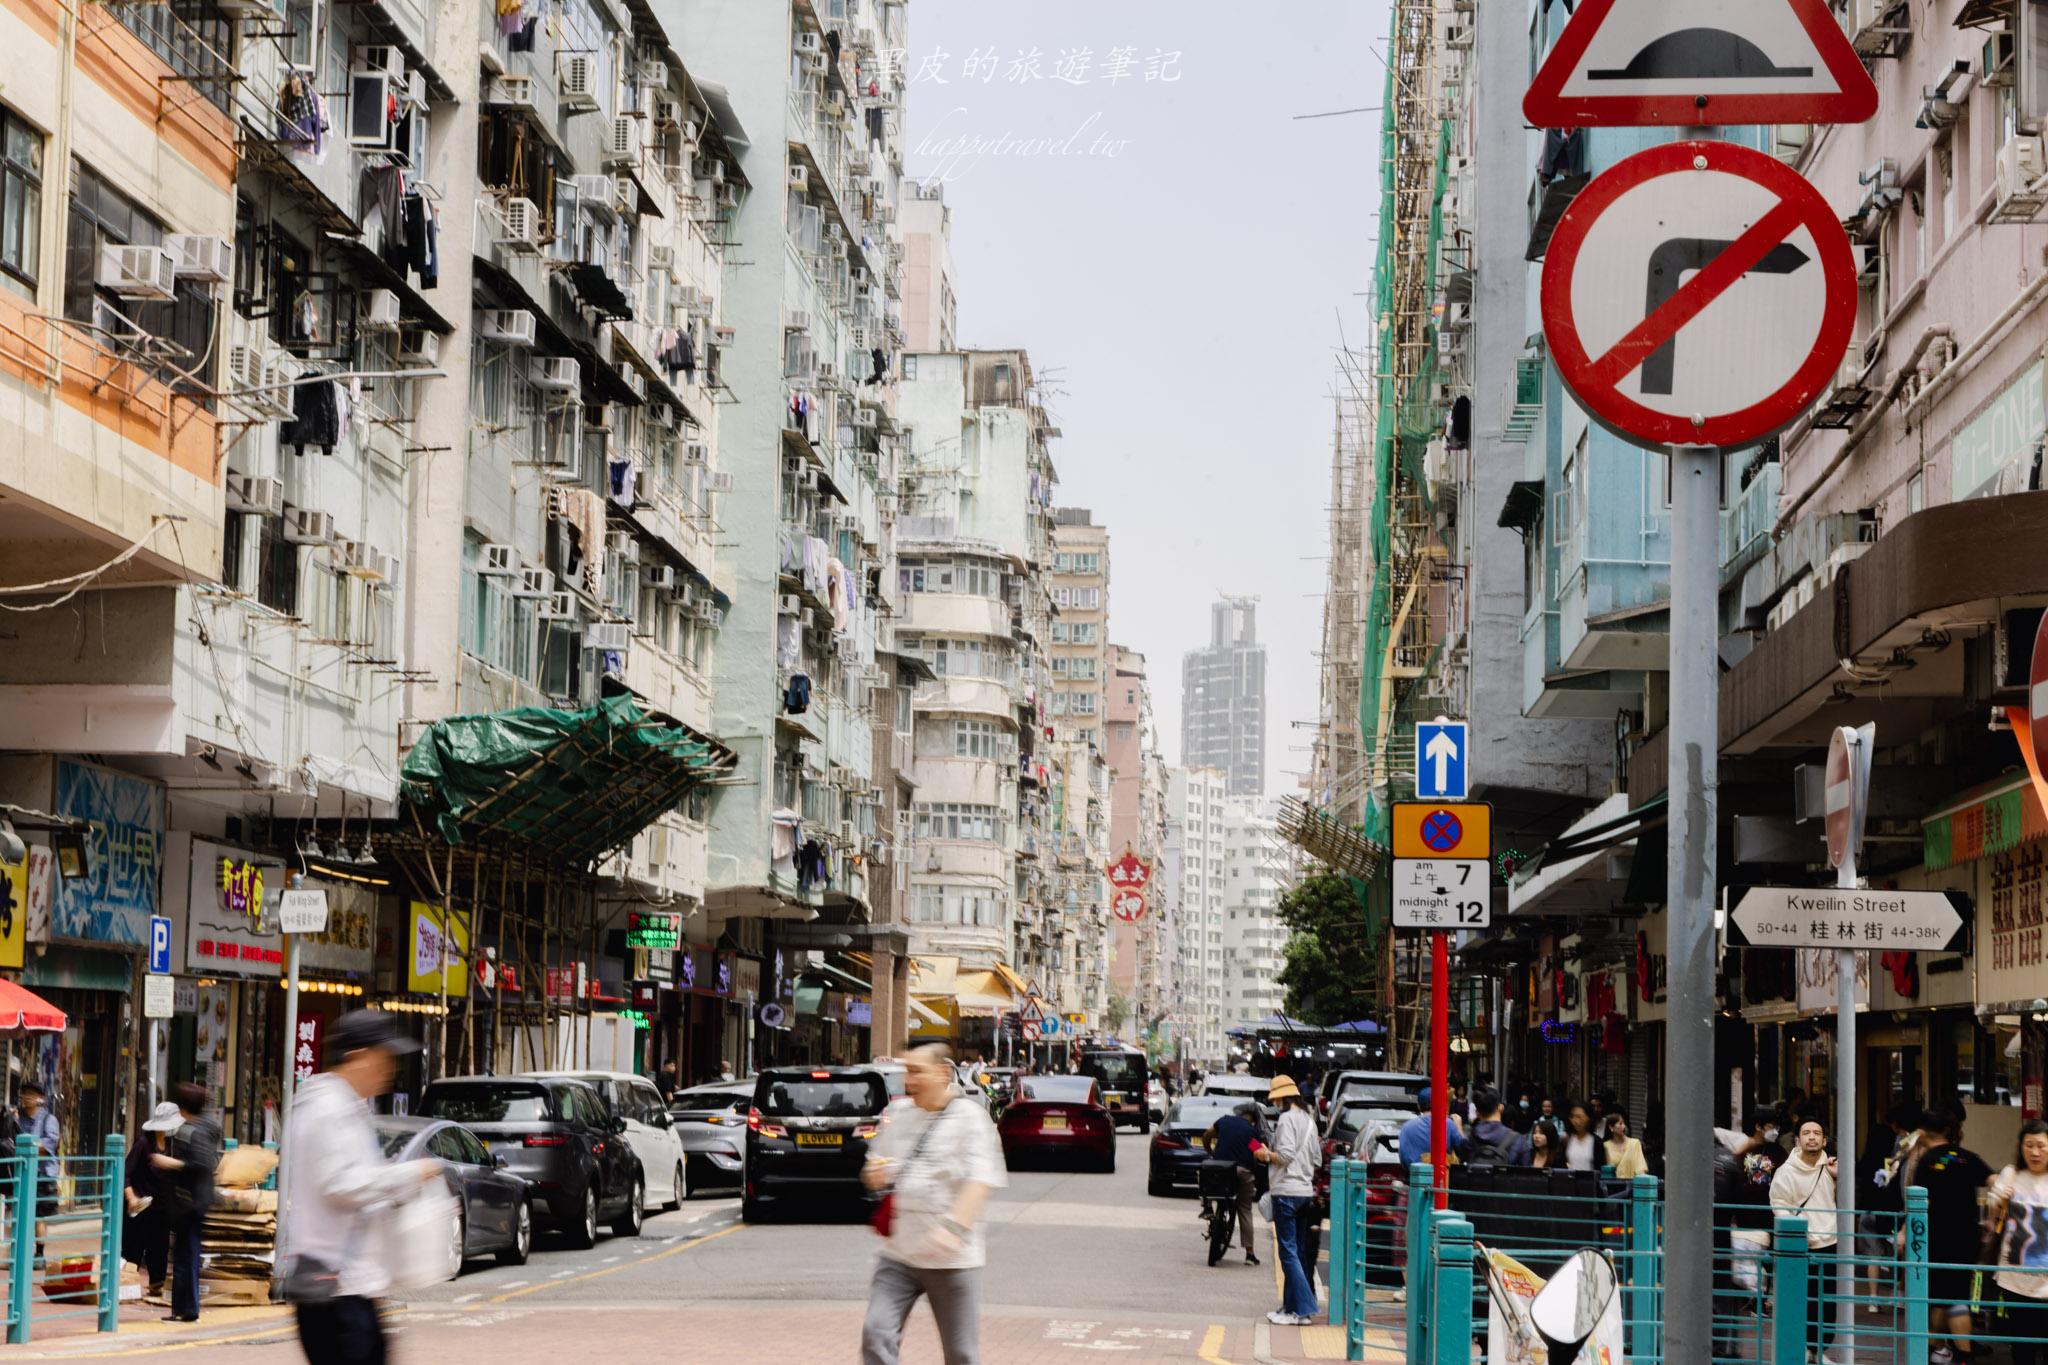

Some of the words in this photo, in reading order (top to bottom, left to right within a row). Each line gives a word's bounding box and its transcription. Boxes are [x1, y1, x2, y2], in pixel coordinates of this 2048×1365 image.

[1410, 873, 1439, 886] 上午
[1416, 862, 1433, 870] am
[1455, 864, 1472, 885] 7
[1115, 891, 1143, 920] 押
[1399, 897, 1449, 908] midnight
[1455, 902, 1483, 923] 12
[1787, 895, 1847, 911] Kweilin
[1852, 898, 1907, 913] Street
[1410, 910, 1438, 923] 午夜
[1756, 921, 1797, 934] 50-44
[1809, 920, 1883, 941] 桂林街
[1890, 927, 1941, 939] 44-38K
[154, 922, 168, 966] P
